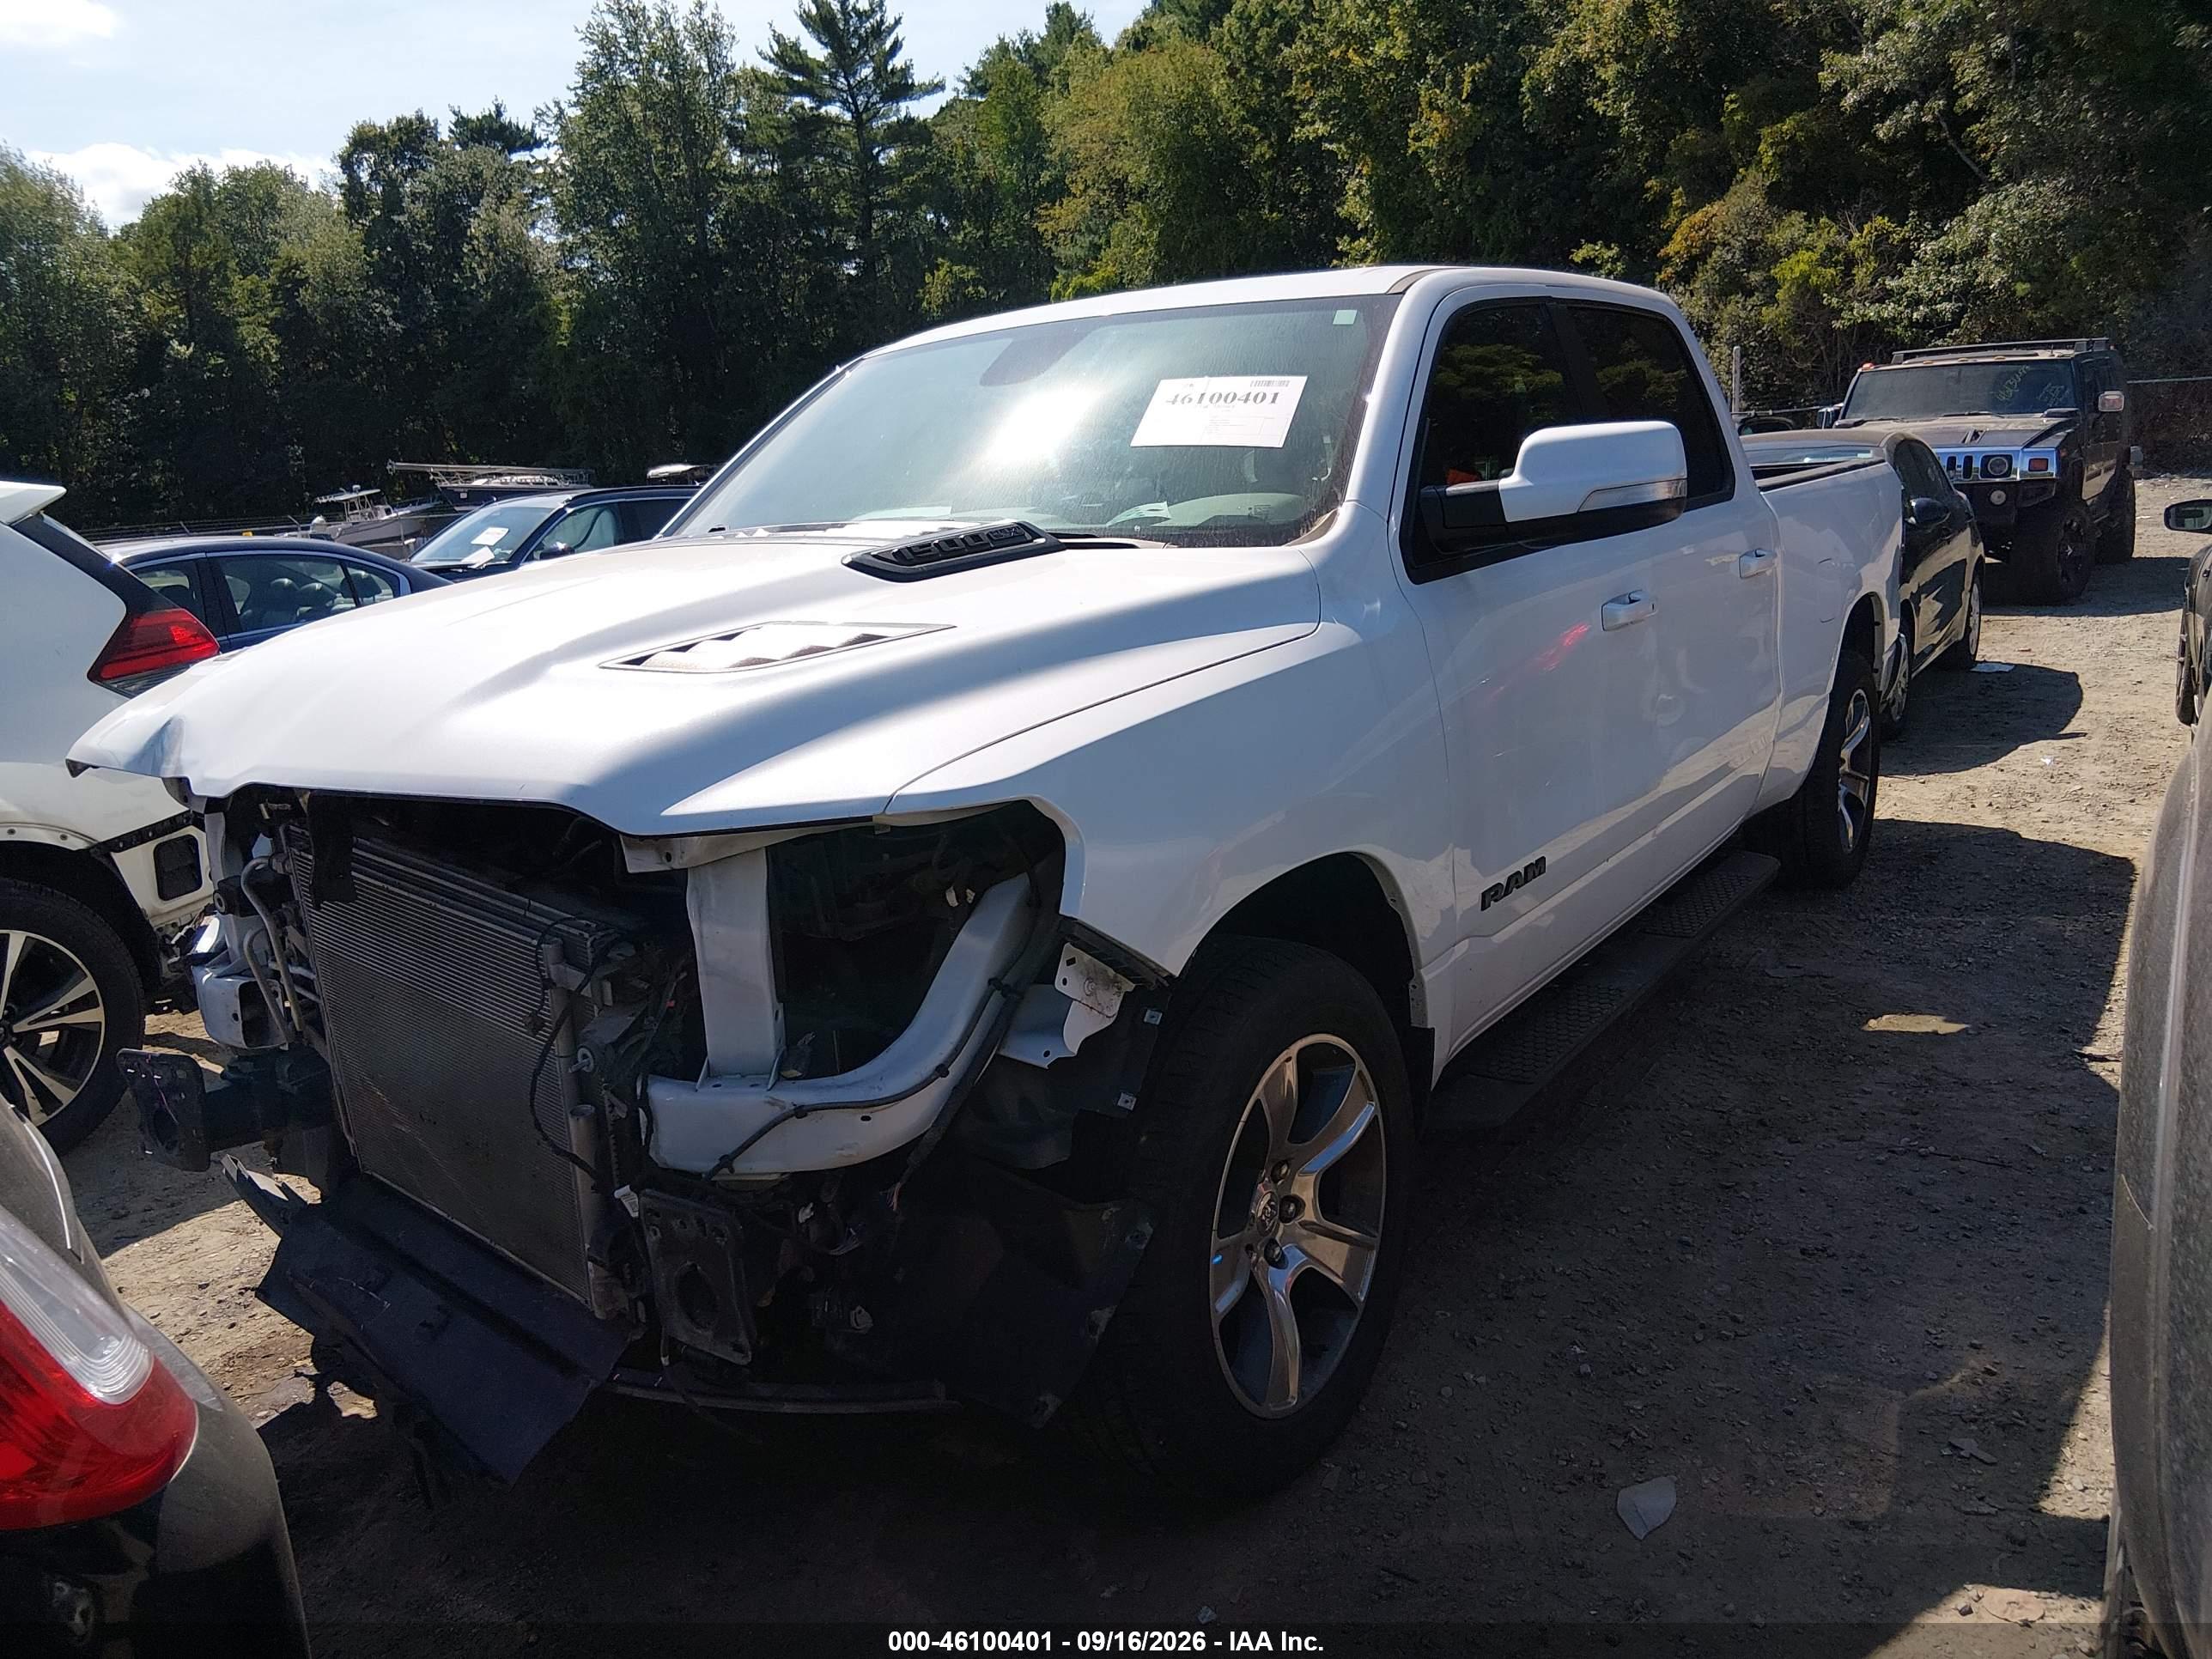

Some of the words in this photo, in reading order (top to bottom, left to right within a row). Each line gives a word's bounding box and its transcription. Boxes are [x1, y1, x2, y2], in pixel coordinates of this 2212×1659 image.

[1164, 391, 1280, 406] 46100401
[898, 532, 988, 562] 1500
[1480, 855, 1547, 912] RAM
